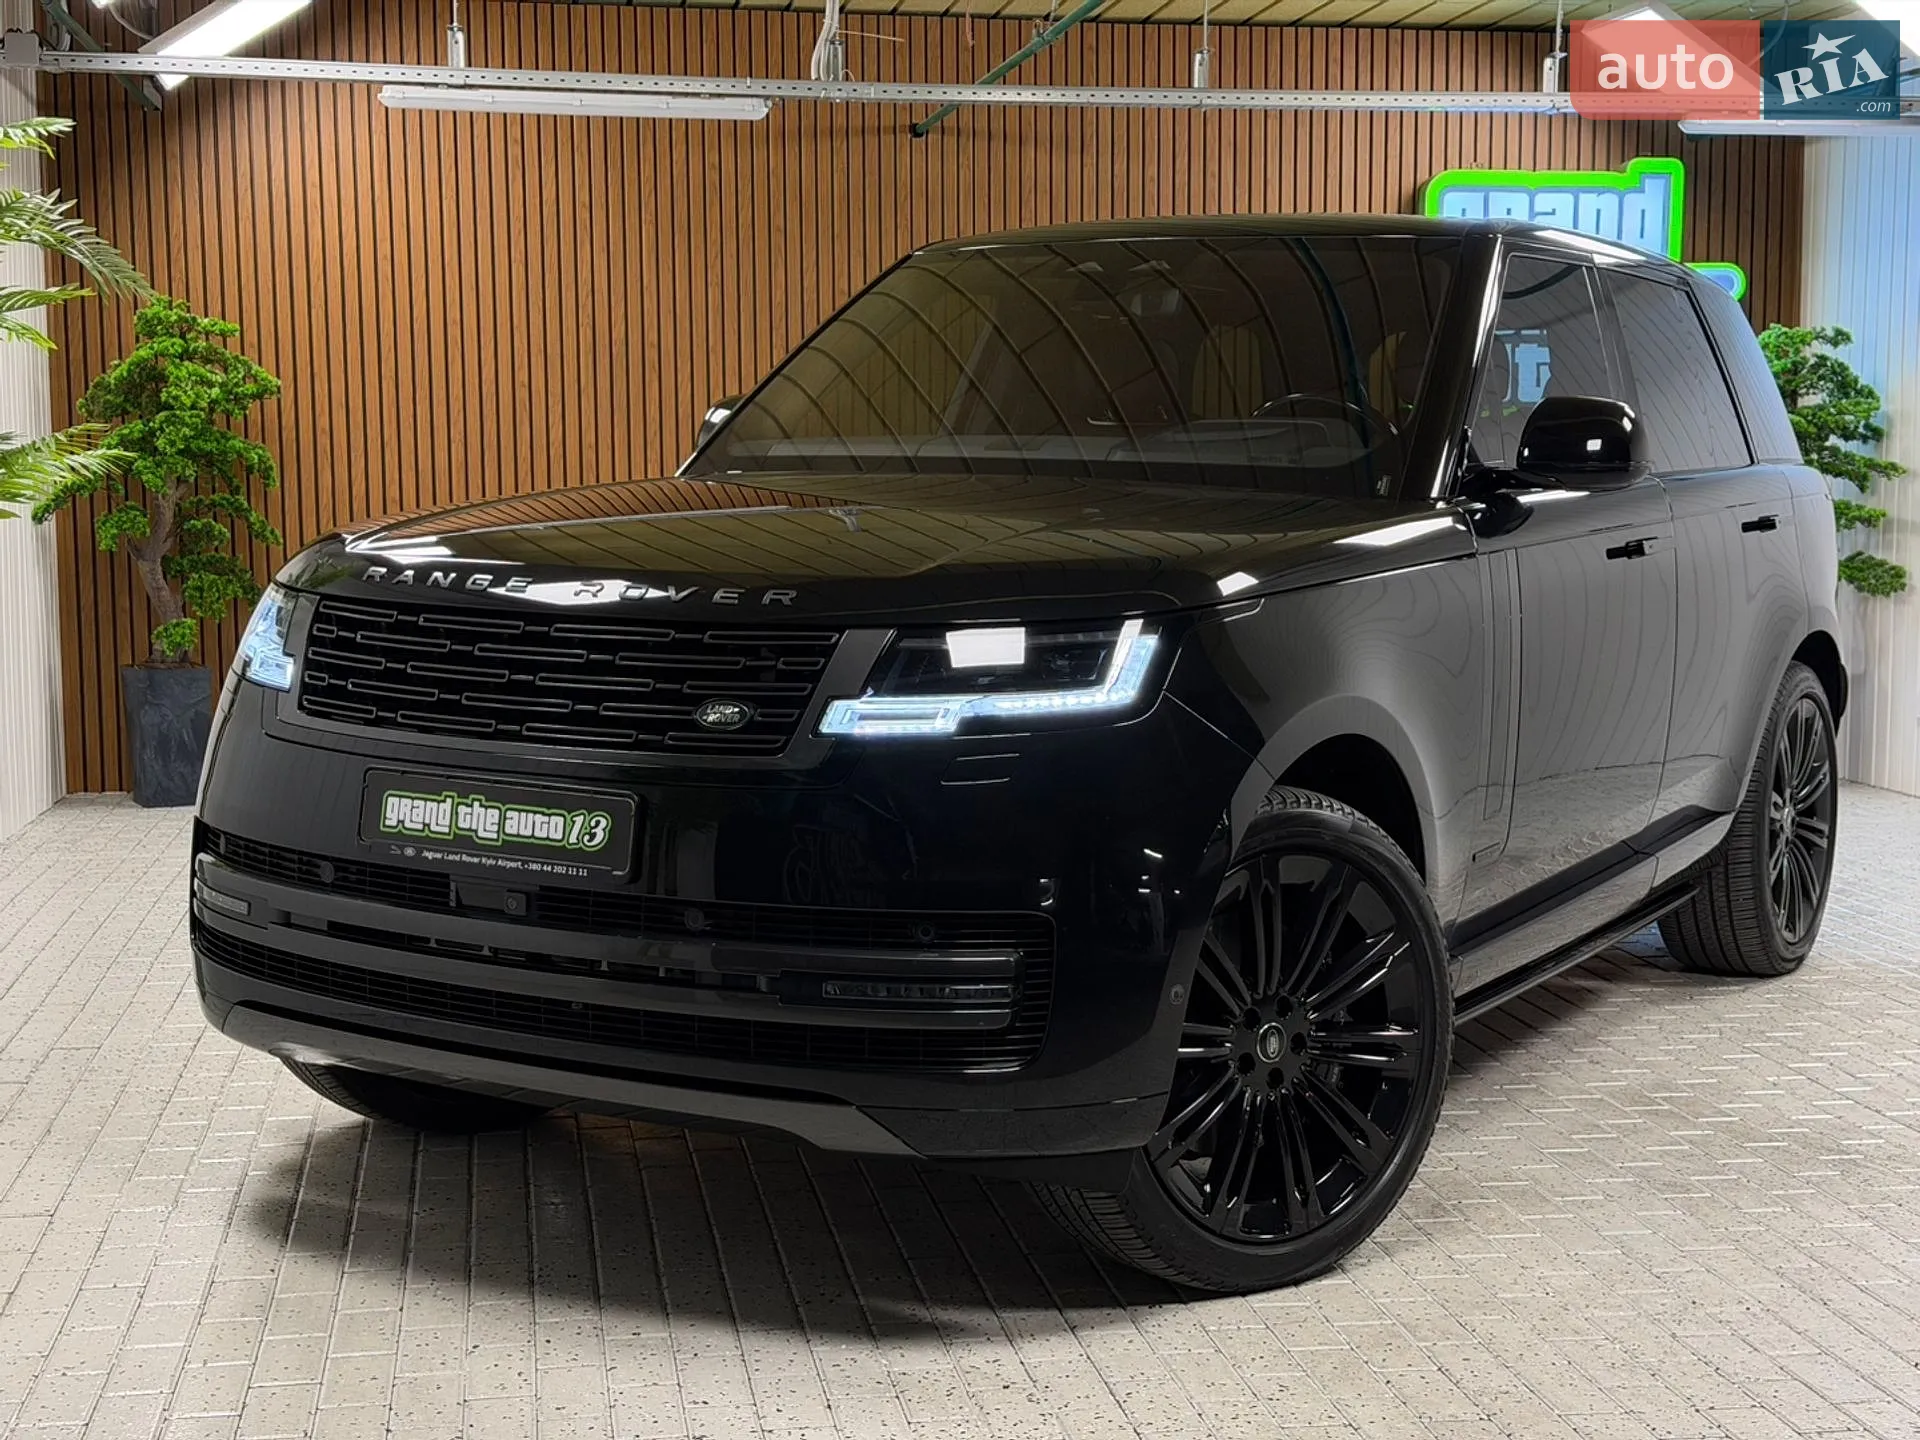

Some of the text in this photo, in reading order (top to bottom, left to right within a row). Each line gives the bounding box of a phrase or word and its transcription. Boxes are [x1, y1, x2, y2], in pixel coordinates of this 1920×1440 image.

[362, 566, 798, 606] RANGE ROVER
[706, 704, 733, 714] LAND
[706, 713, 740, 723] ROVER
[457, 801, 500, 840] the
[504, 809, 565, 841] auto
[568, 814, 608, 847] 13
[422, 849, 443, 861] Jaguar
[444, 852, 460, 862] Land
[461, 853, 480, 864] Rover
[542, 864, 552, 873] 44
[552, 865, 567, 875] 202
[568, 866, 578, 876] 11
[578, 868, 588, 877] 11
